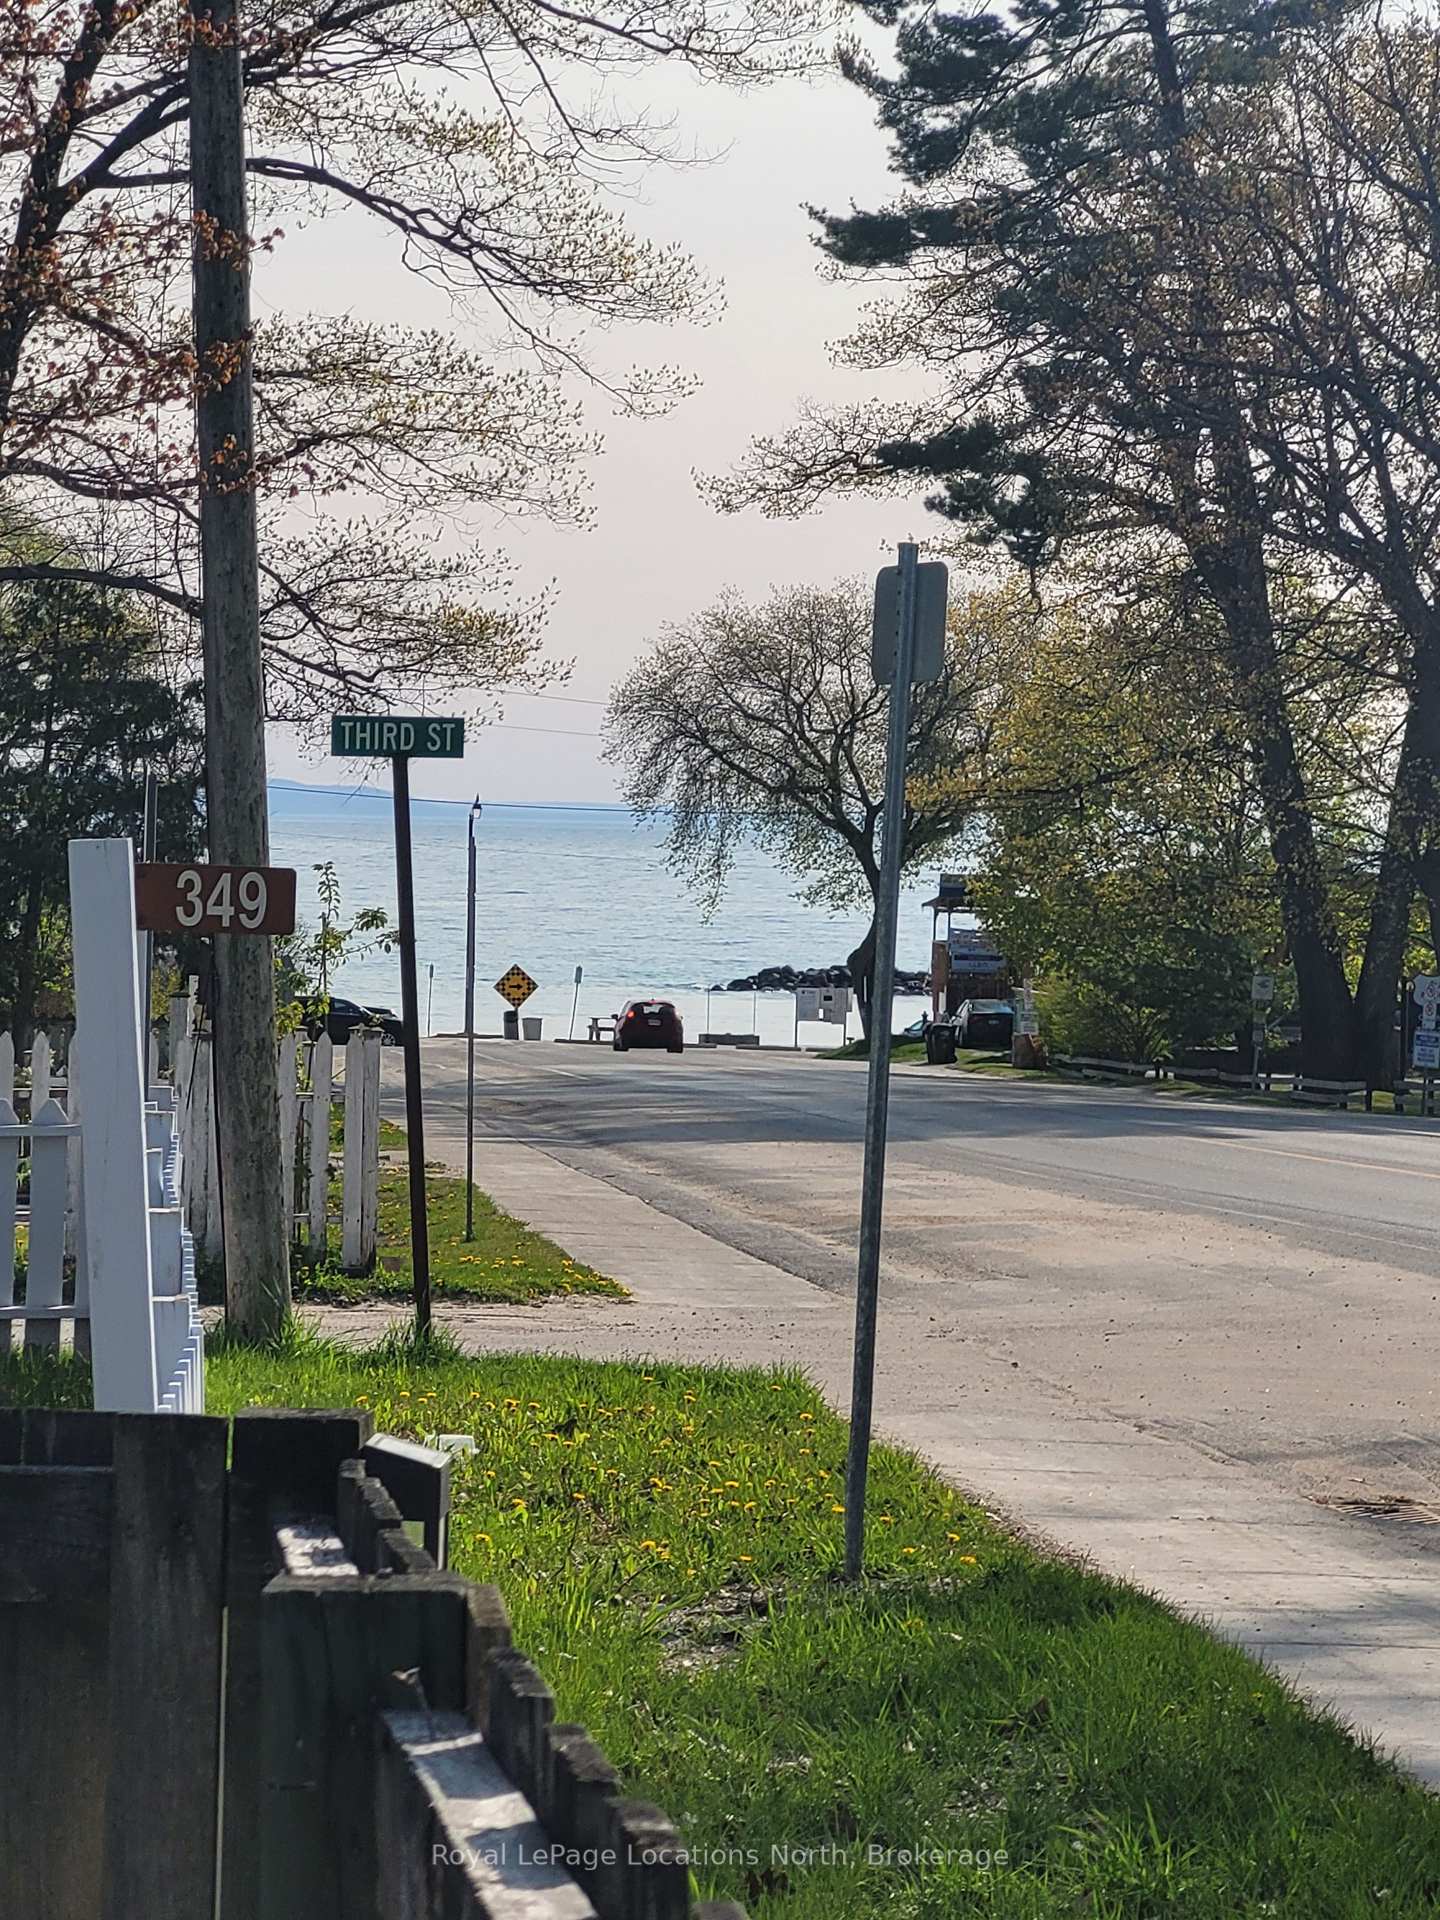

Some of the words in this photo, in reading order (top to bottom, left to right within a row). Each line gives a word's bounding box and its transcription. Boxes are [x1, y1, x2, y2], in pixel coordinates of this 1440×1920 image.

[340, 721, 415, 751] THIRD
[426, 722, 456, 752] ST
[175, 869, 267, 929] 349
